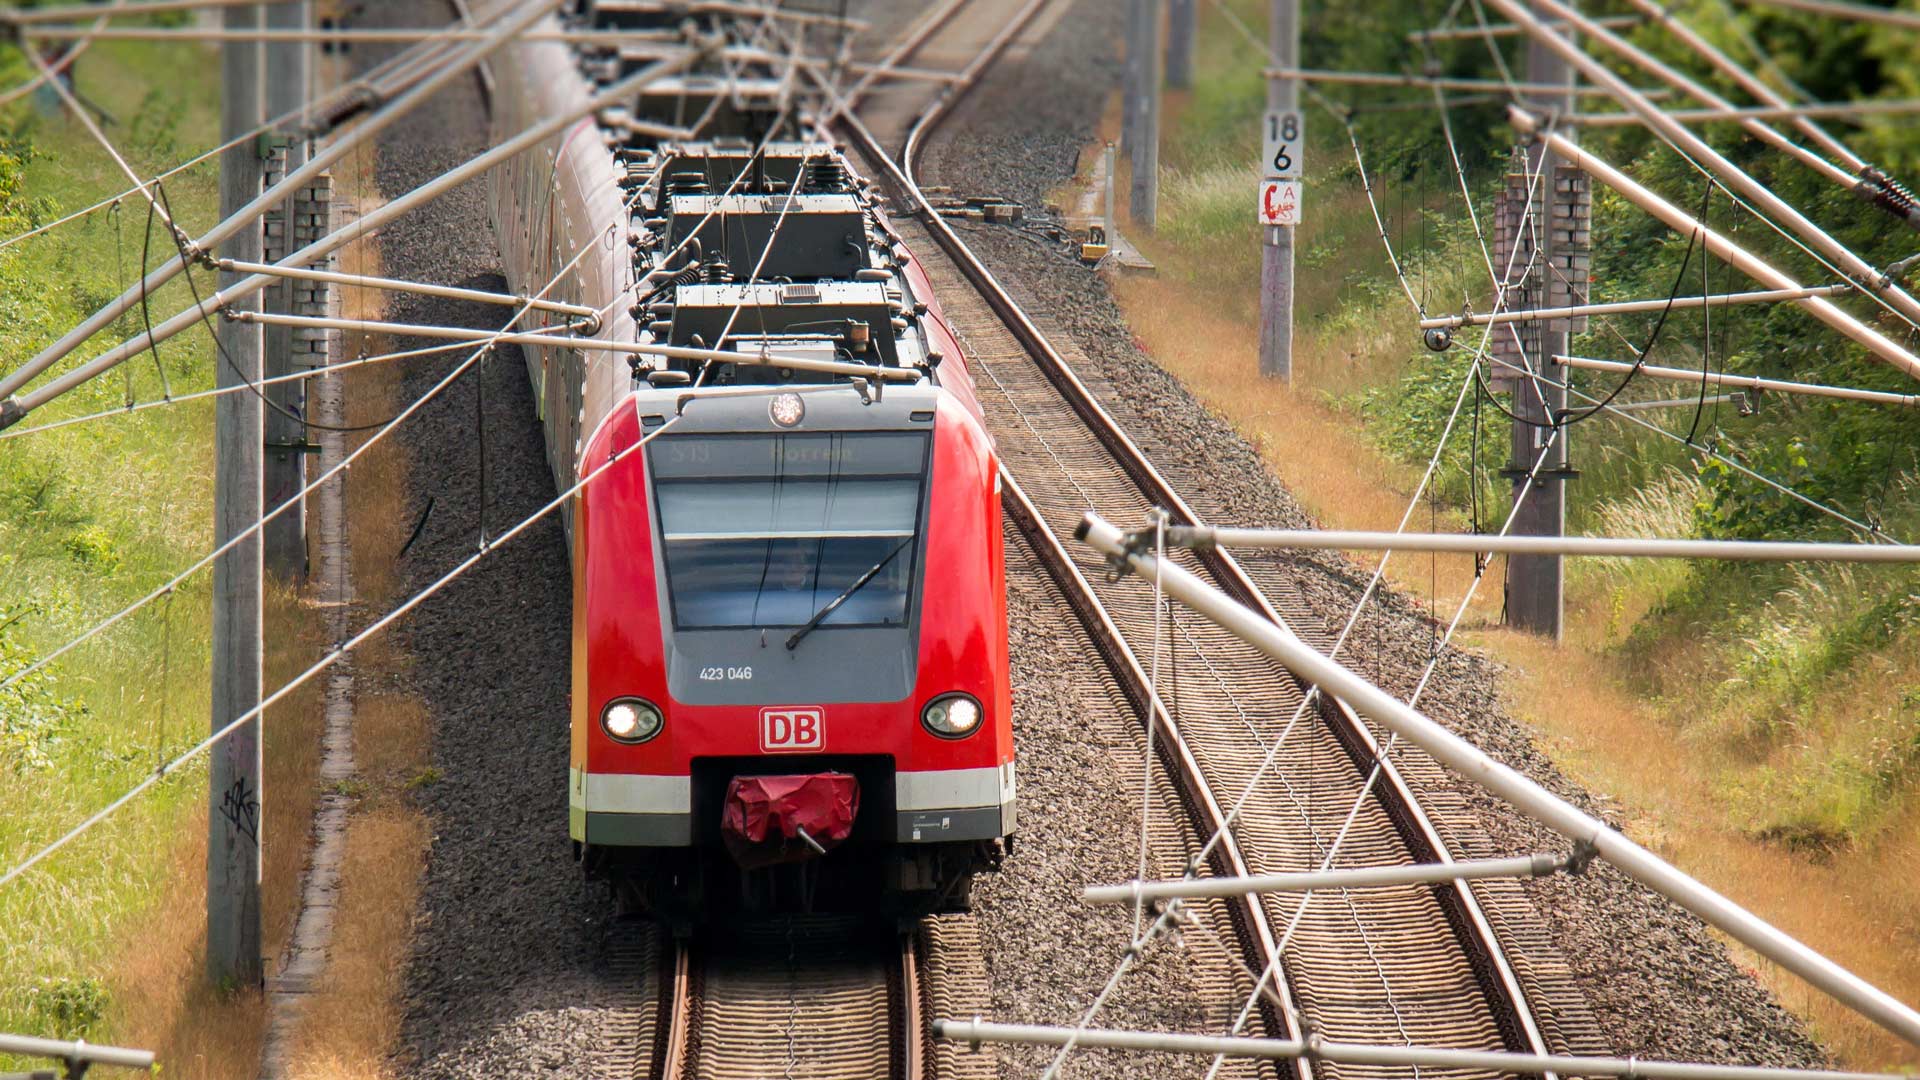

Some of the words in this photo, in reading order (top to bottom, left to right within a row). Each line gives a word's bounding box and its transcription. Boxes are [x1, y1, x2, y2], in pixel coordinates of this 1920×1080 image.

[1269, 114, 1298, 141] 18
[1274, 145, 1291, 171] 6
[1284, 186, 1295, 200] A
[700, 667, 724, 680] 423
[727, 666, 752, 680] 046
[768, 714, 817, 744] DB
